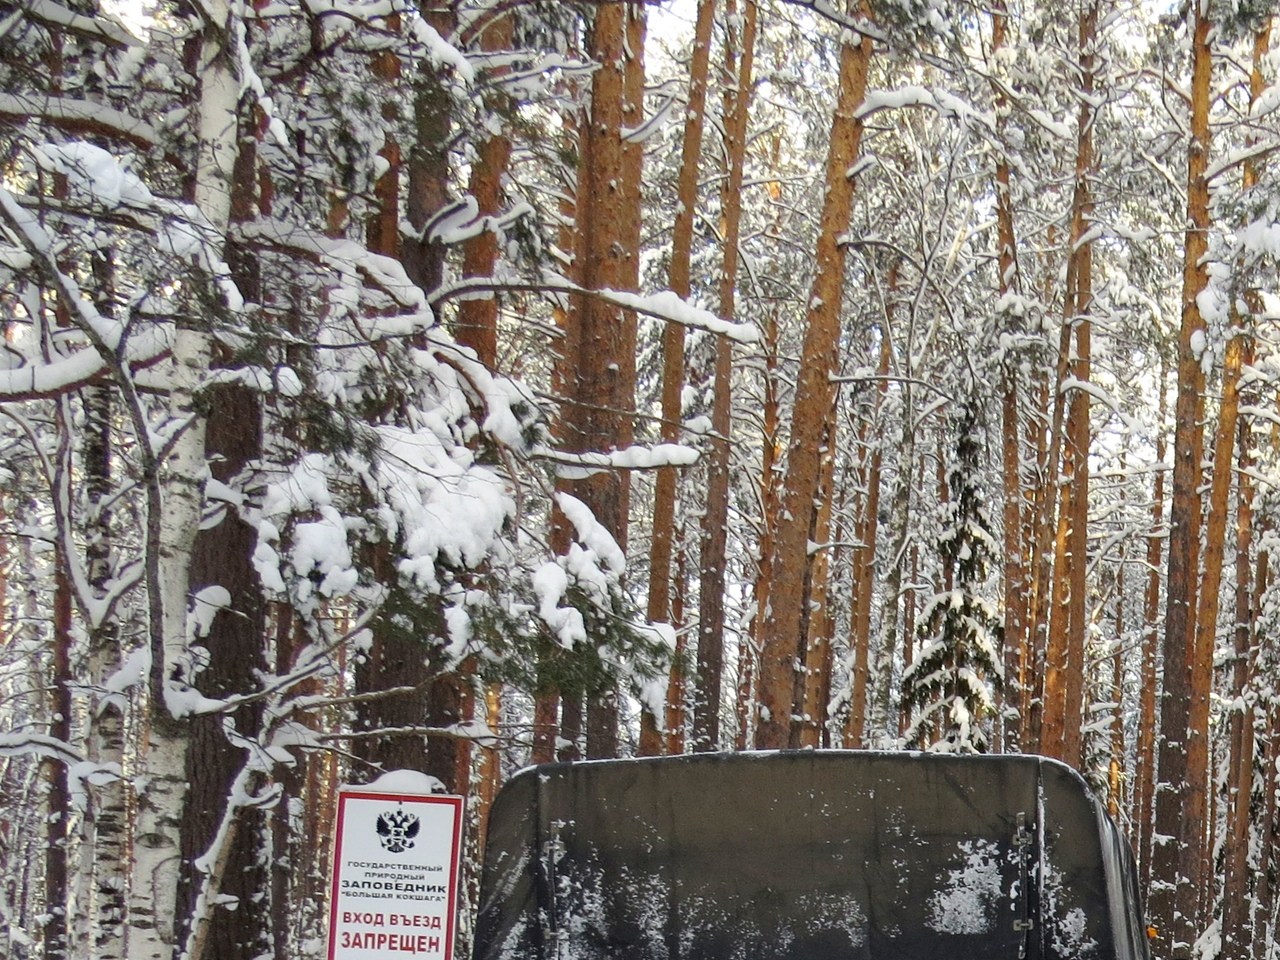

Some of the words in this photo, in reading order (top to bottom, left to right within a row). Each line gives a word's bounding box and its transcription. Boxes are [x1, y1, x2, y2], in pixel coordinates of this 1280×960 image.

[347, 861, 443, 872] ГОСУДАРСТВЕННЫЙ
[364, 872, 425, 881] ПРИРОДНЫЙ
[341, 880, 446, 893] ЗАПОВЕДНИК
[343, 912, 385, 927] ВХОД
[389, 914, 442, 930] ВЪЕЗД
[341, 932, 440, 954] ЗАПРЕЩЕН
